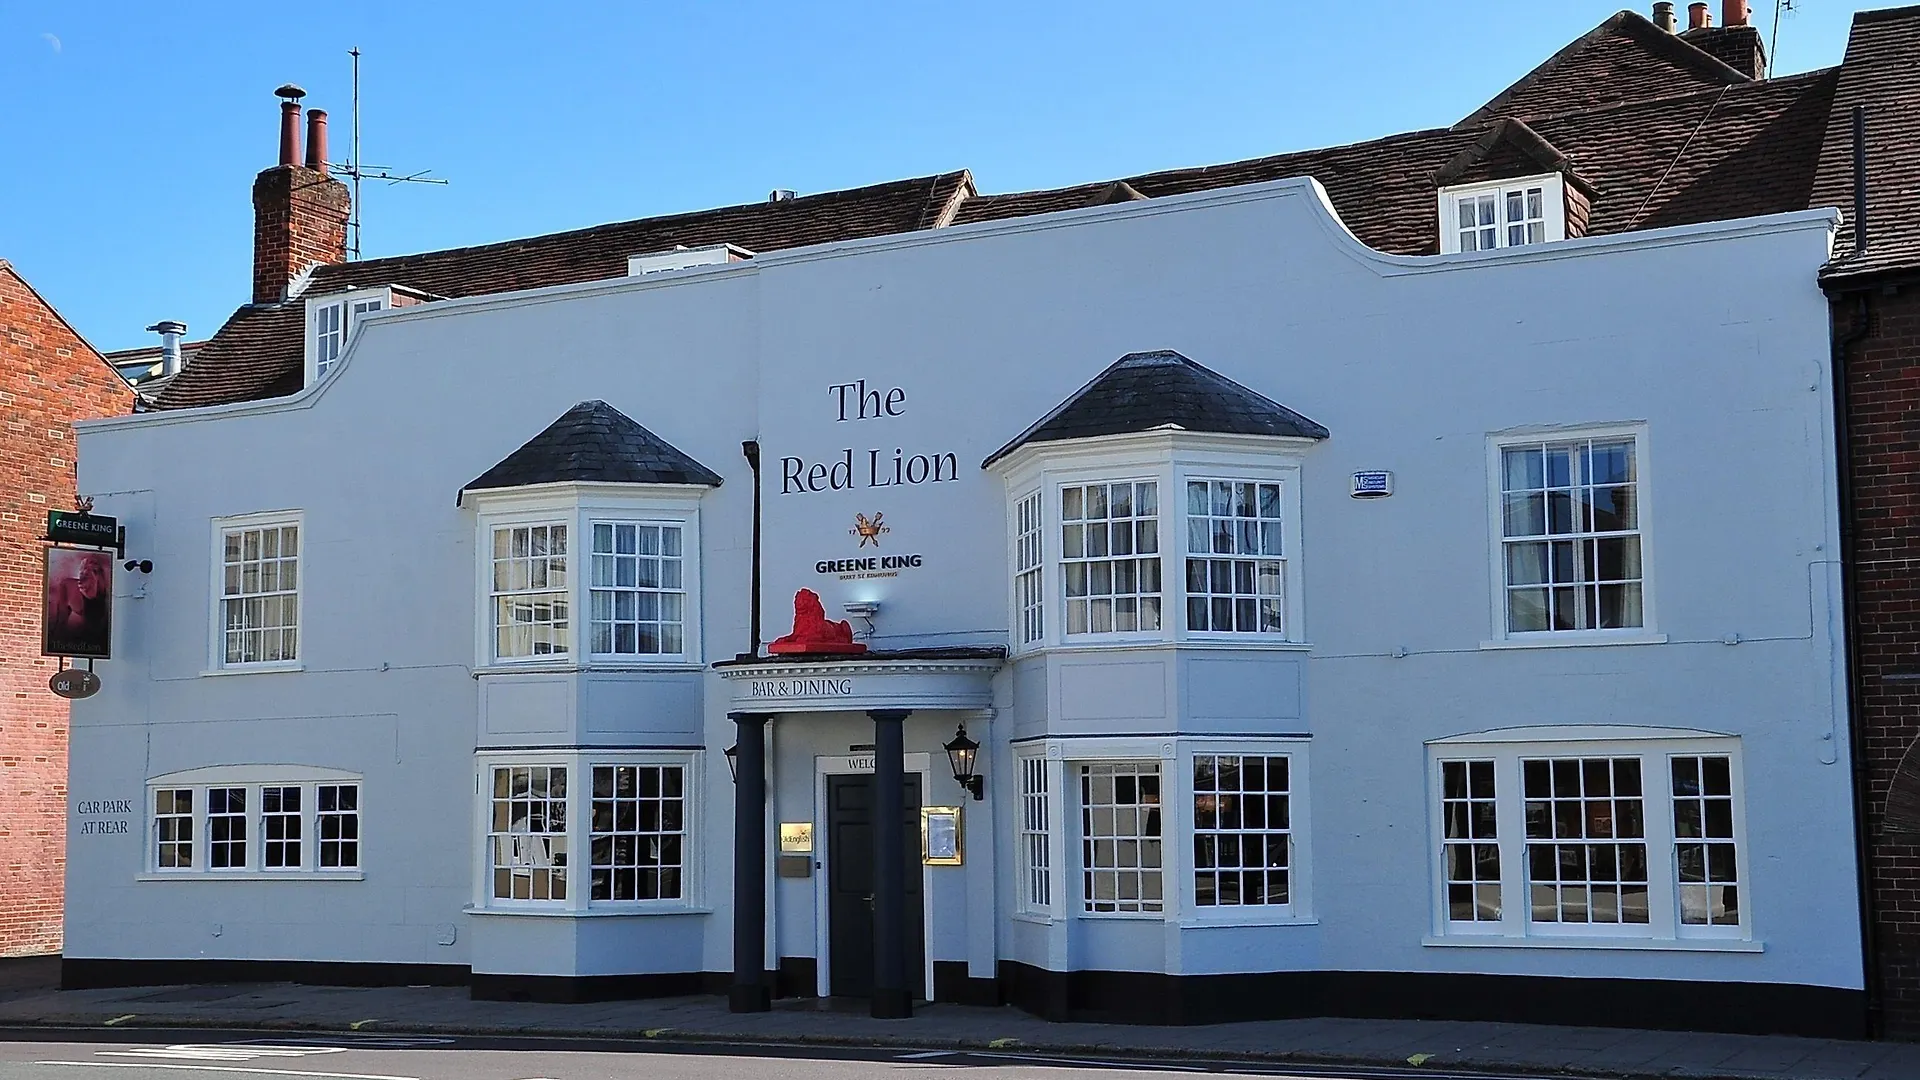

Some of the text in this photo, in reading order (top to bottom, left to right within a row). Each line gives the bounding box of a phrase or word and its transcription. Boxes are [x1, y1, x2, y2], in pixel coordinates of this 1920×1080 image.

[828, 378, 906, 422] The
[780, 447, 959, 495] Red Lion
[55, 518, 89, 531] GREENE
[91, 523, 113, 534] KING
[815, 554, 922, 573] GREENE KING
[57, 680, 70, 692] Old
[752, 679, 852, 697] BAR & DINING
[848, 759, 874, 769] WELC
[78, 800, 132, 814] CAR PARK
[81, 820, 128, 834] AT REAR
